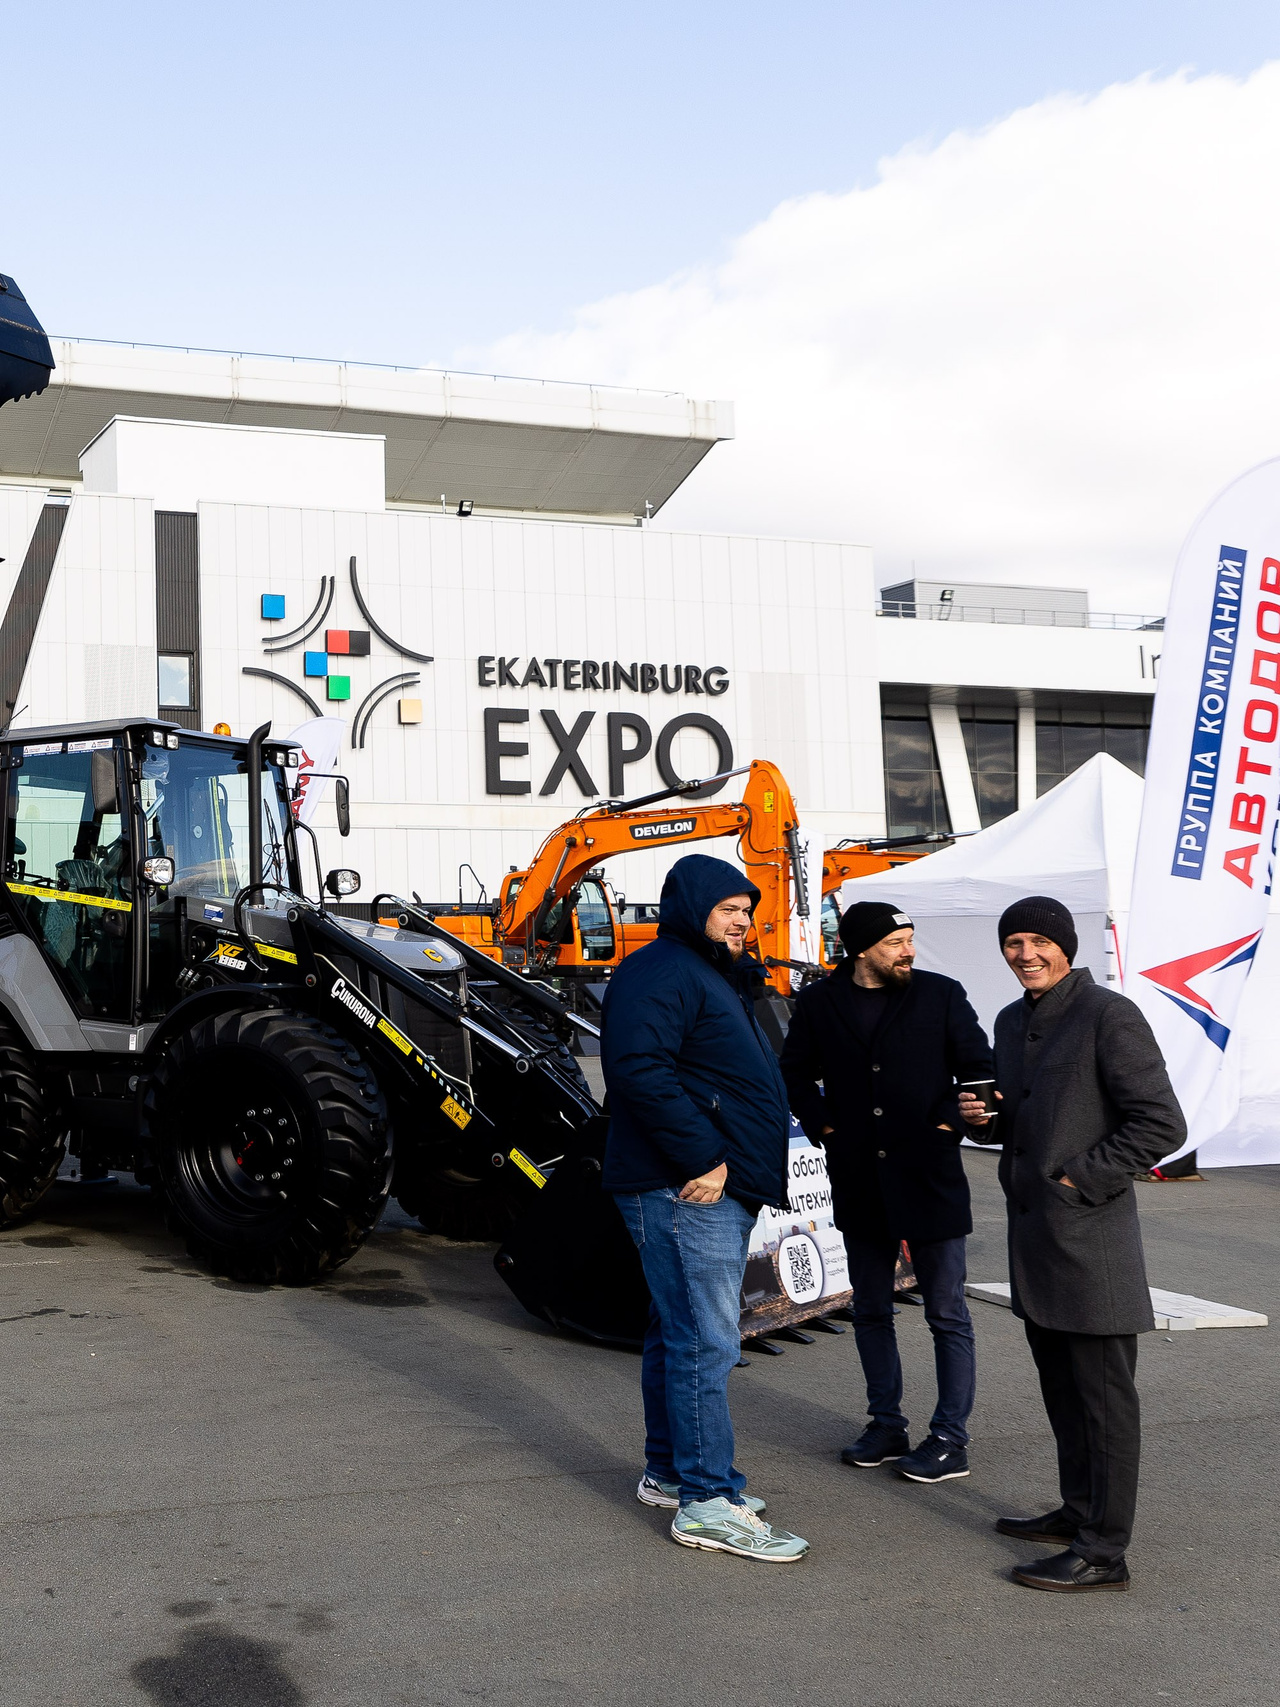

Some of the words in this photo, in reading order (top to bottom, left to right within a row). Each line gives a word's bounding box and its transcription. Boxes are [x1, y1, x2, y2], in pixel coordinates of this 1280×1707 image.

[477, 655, 730, 696] EKATERINBURG
[1176, 751, 1217, 868] ГРУППА
[1198, 557, 1243, 735] КОМПАНИЙ
[484, 707, 734, 800] EXPO
[634, 821, 693, 838] DEVELON
[210, 943, 245, 958] XG
[218, 954, 248, 971] 888
[331, 978, 377, 1029] ÇUKUROVA
